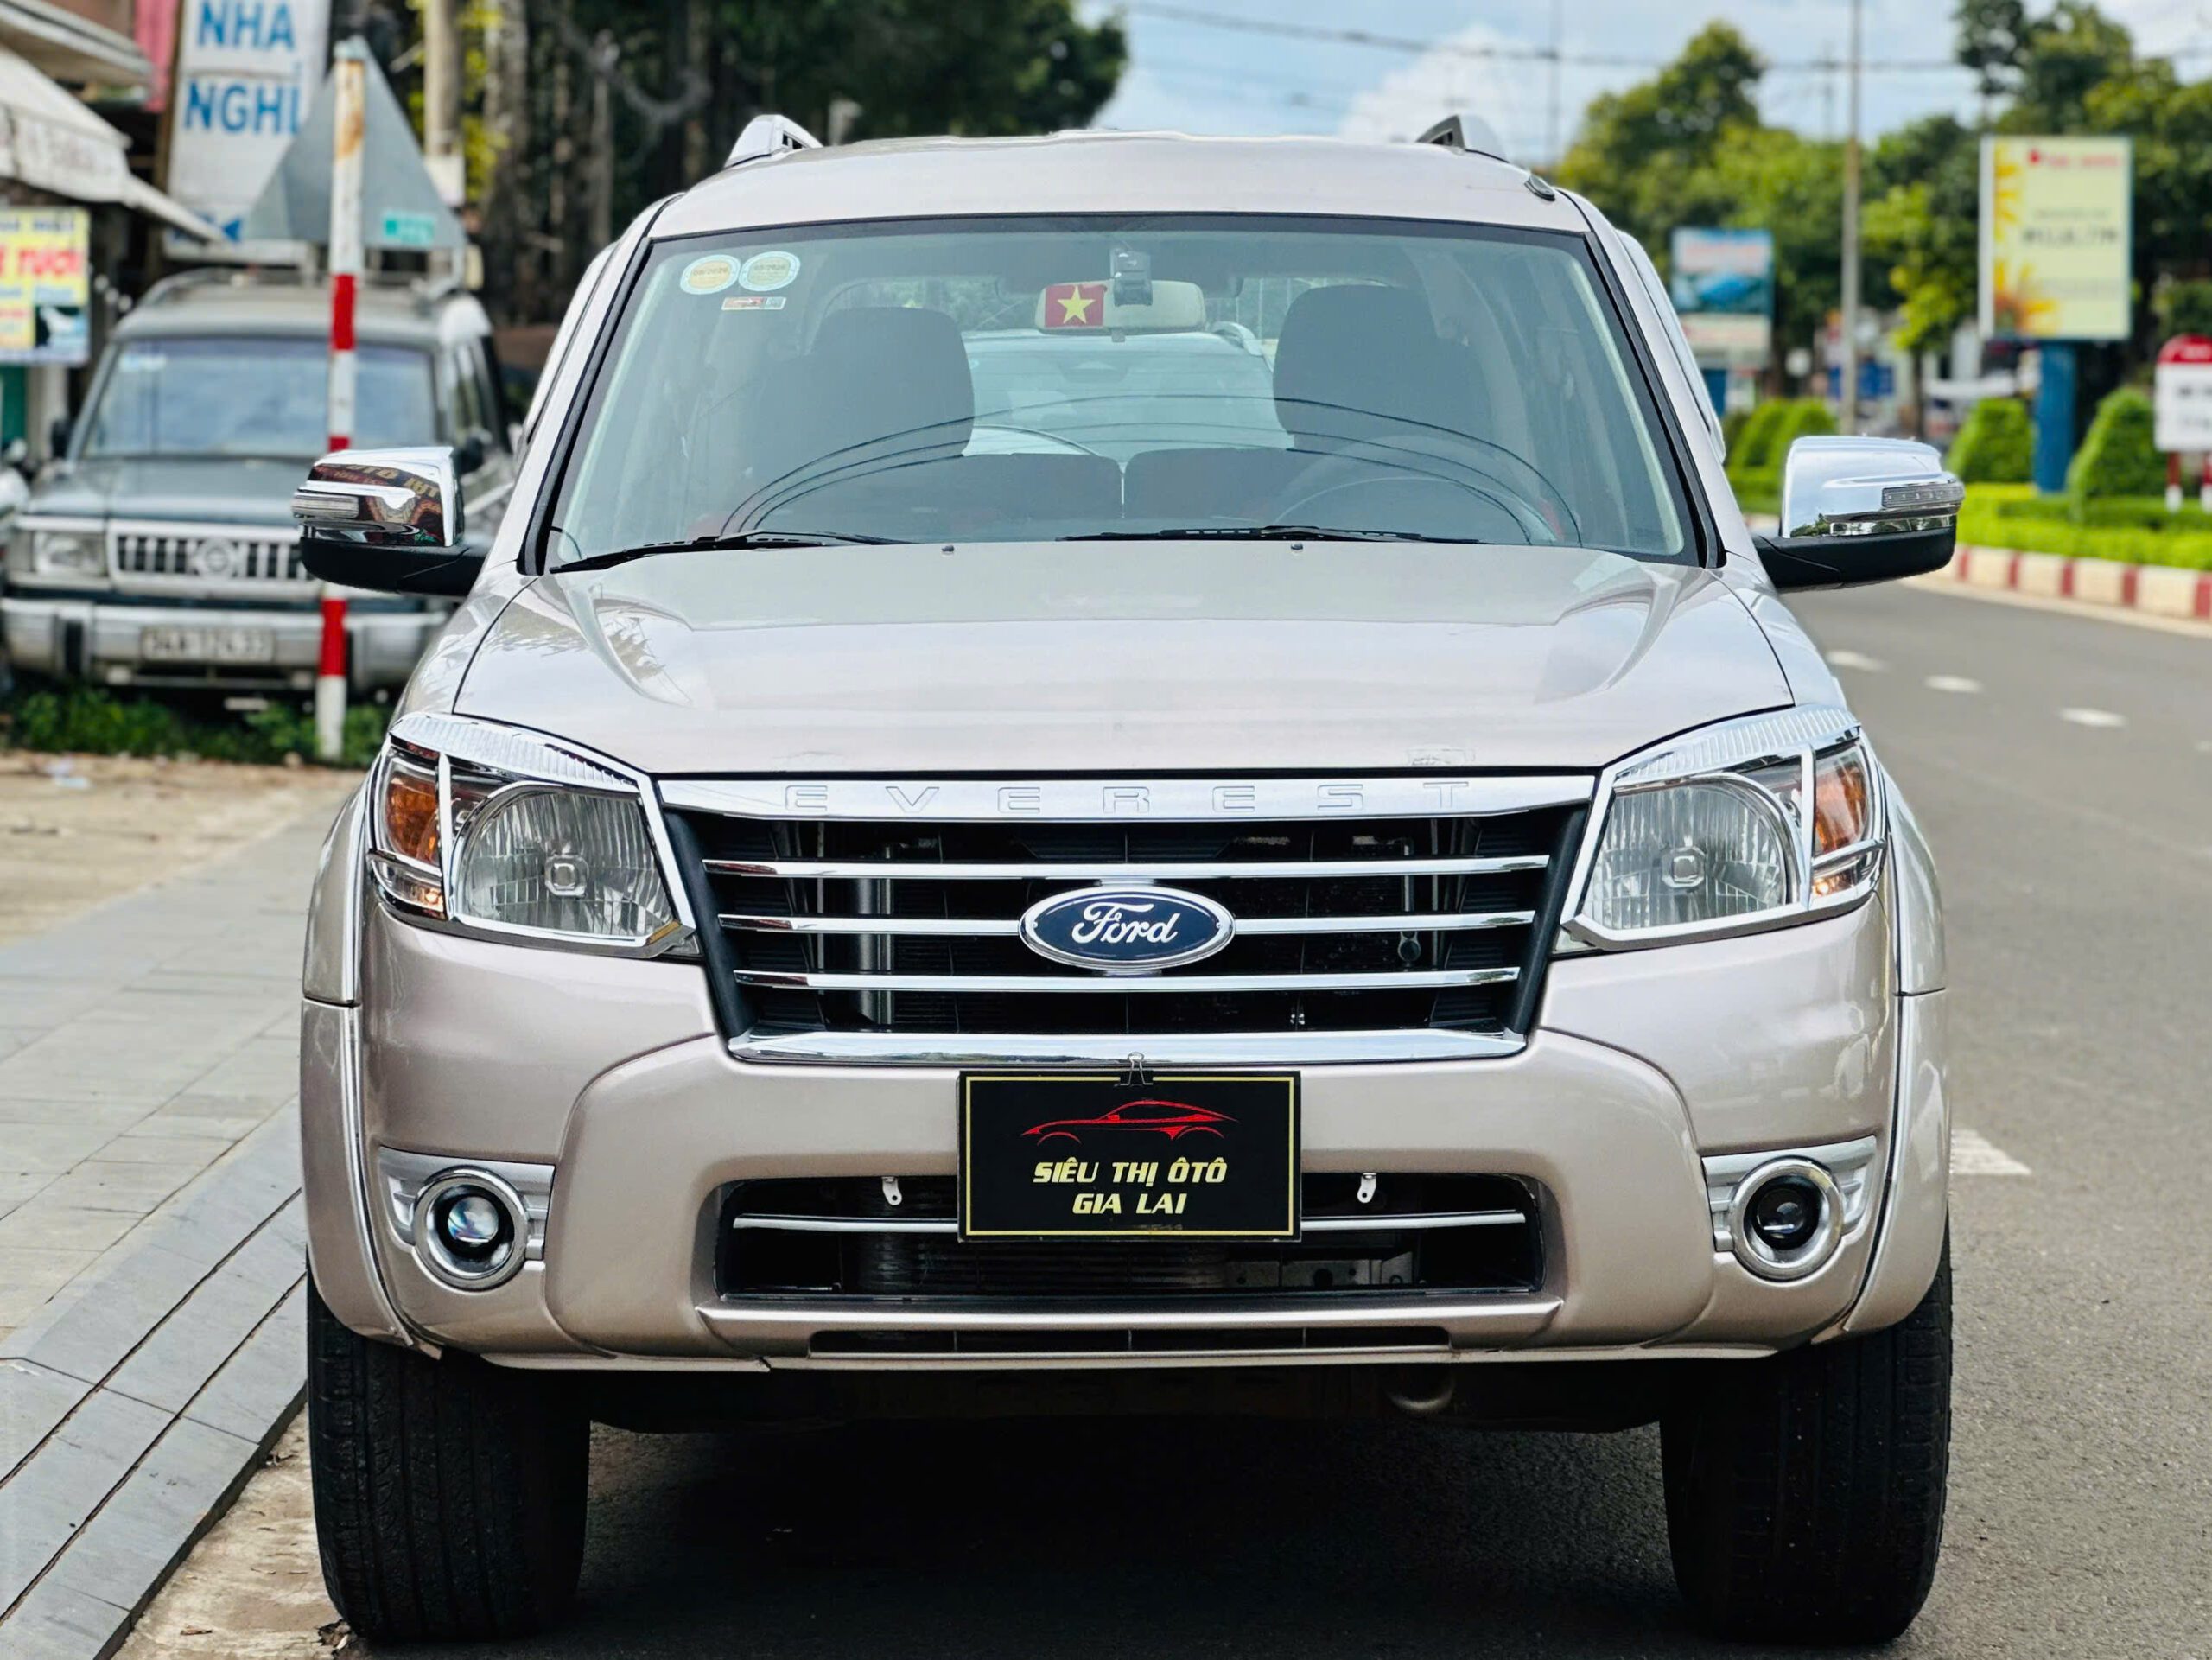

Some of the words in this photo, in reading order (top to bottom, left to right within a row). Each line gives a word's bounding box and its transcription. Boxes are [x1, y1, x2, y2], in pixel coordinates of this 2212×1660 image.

[785, 781, 1469, 814] EVEREST
[1071, 902, 1181, 944] Ford
[1033, 1157, 1100, 1184] SIÊU
[1112, 1162, 1159, 1187] THỊ
[1167, 1157, 1228, 1184] ÔTÔ
[1072, 1193, 1122, 1214] GIA
[1135, 1193, 1187, 1214] LAI
